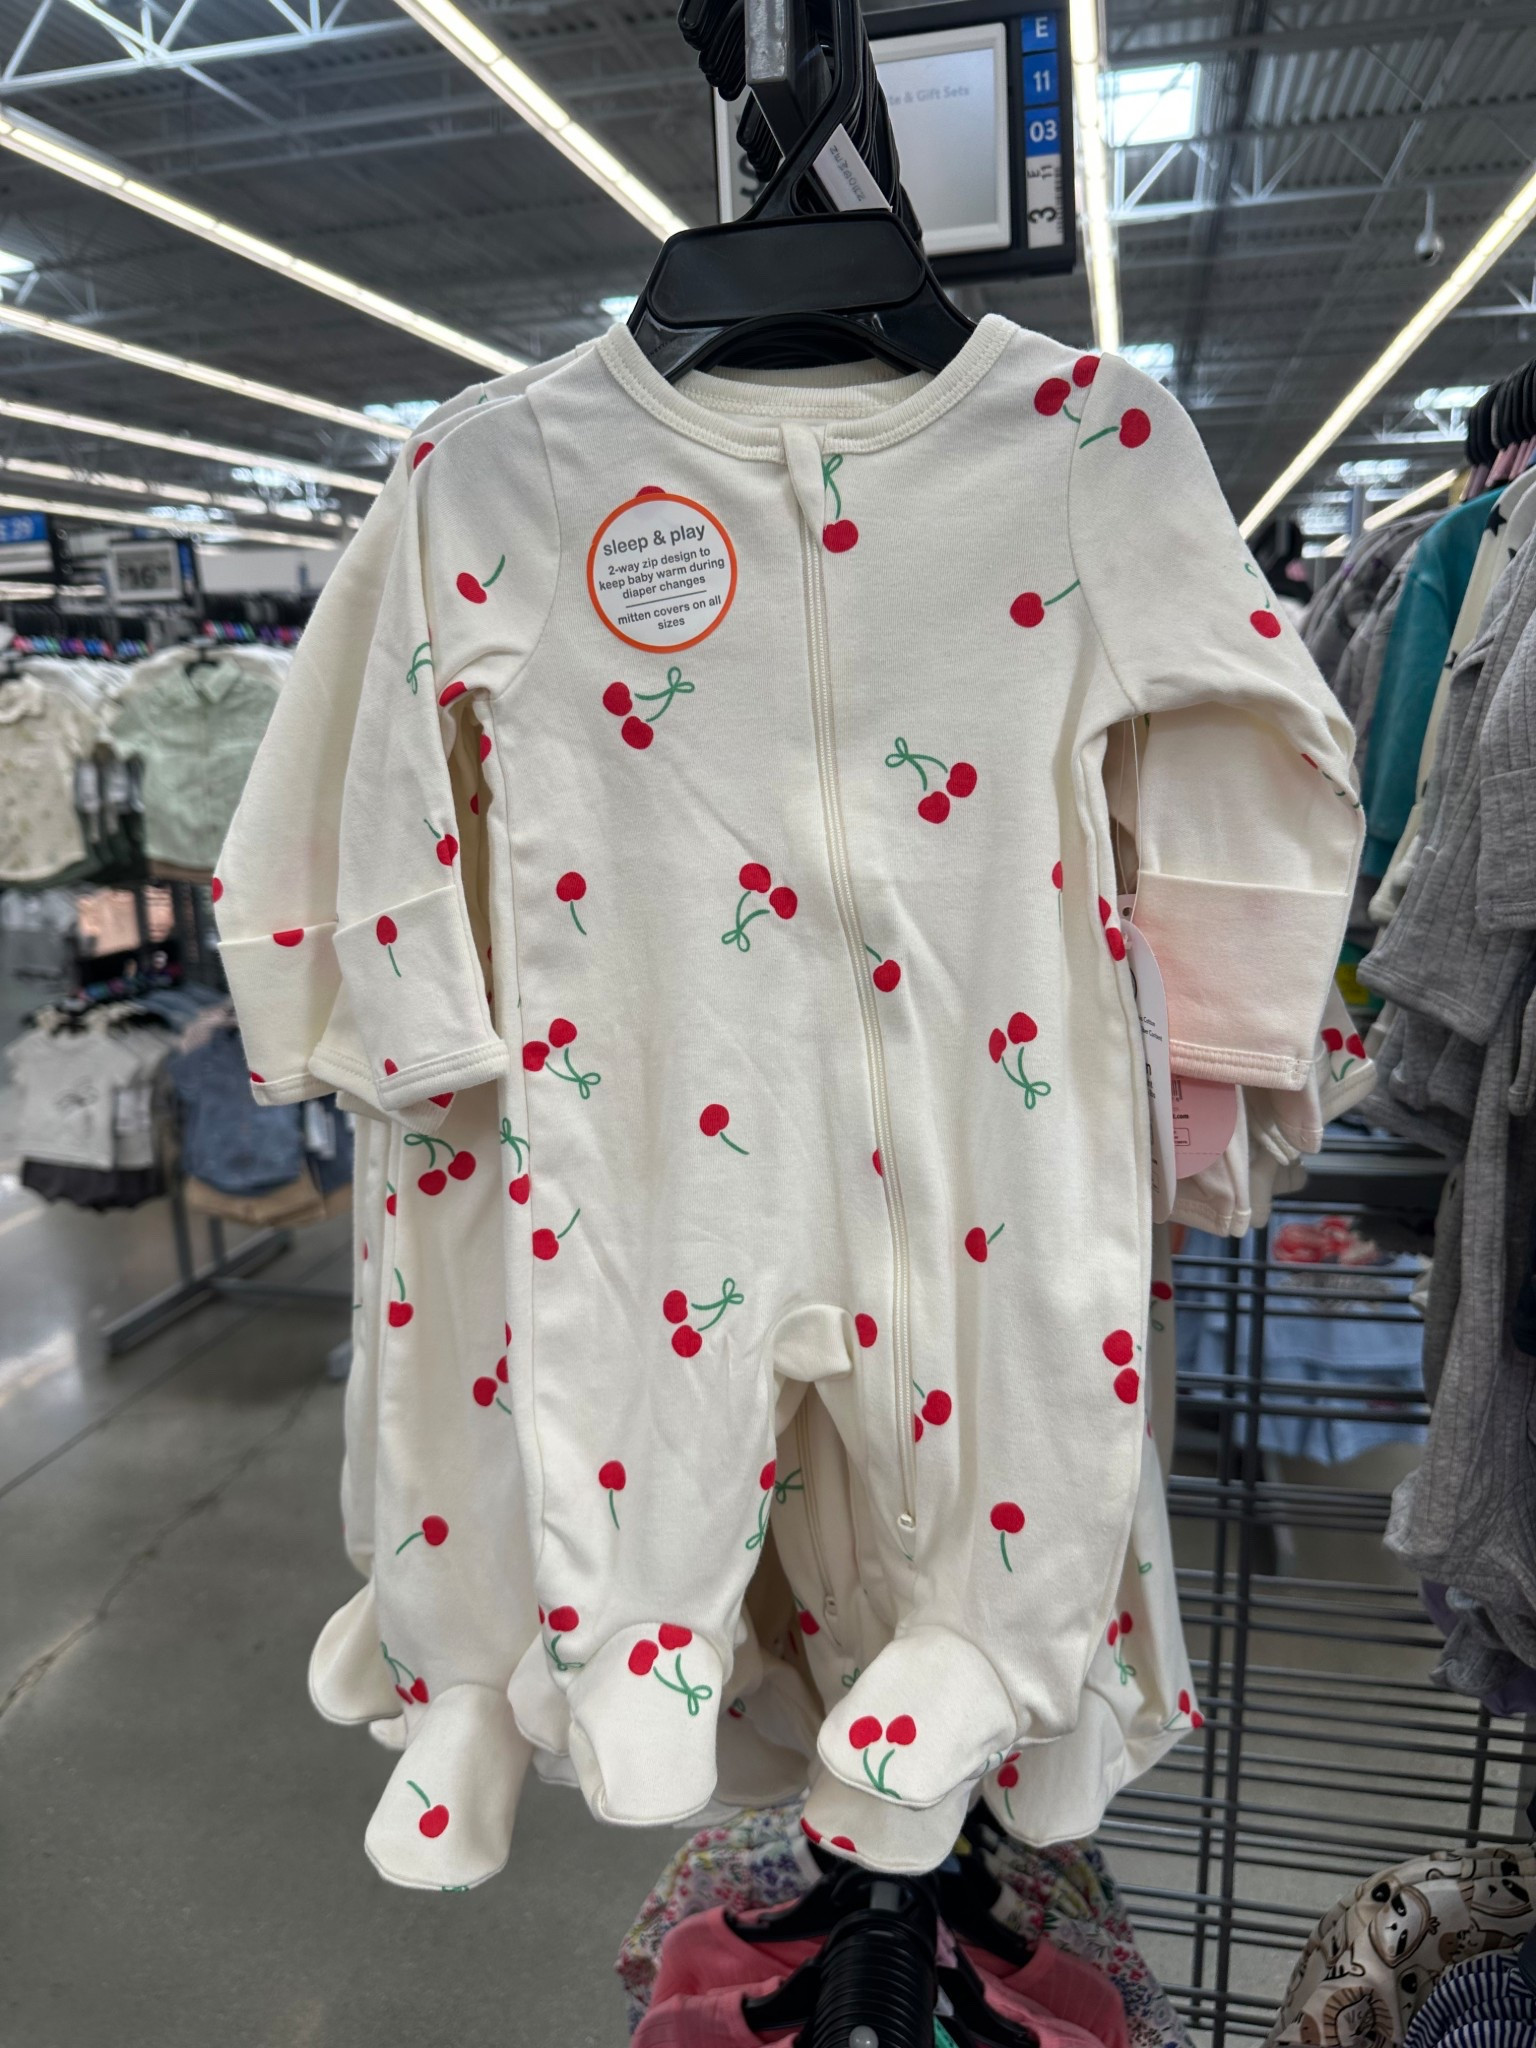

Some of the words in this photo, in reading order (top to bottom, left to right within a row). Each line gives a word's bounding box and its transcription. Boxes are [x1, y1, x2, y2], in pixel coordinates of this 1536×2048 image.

[1035, 17, 1048, 38] E
[1033, 70, 1051, 92] 11
[916, 88, 941, 102] Gift
[943, 85, 970, 99] Sets
[1029, 119, 1057, 143] 03
[1028, 206, 1057, 224] 3
[603, 536, 648, 556] sleep
[653, 530, 666, 546] &
[670, 525, 705, 546] play
[608, 562, 640, 576] 2-way
[642, 557, 658, 569] zip
[661, 550, 697, 565] design
[699, 547, 711, 557] to
[599, 578, 625, 591] keep
[628, 573, 653, 586] baby
[656, 567, 687, 579] warm
[689, 558, 725, 572] during
[622, 585, 656, 599] diaper
[659, 575, 706, 592] changes
[618, 610, 651, 625] mitten
[653, 603, 690, 618] covers
[693, 599, 707, 609] on
[708, 595, 722, 608] all
[657, 616, 685, 630] sizes
